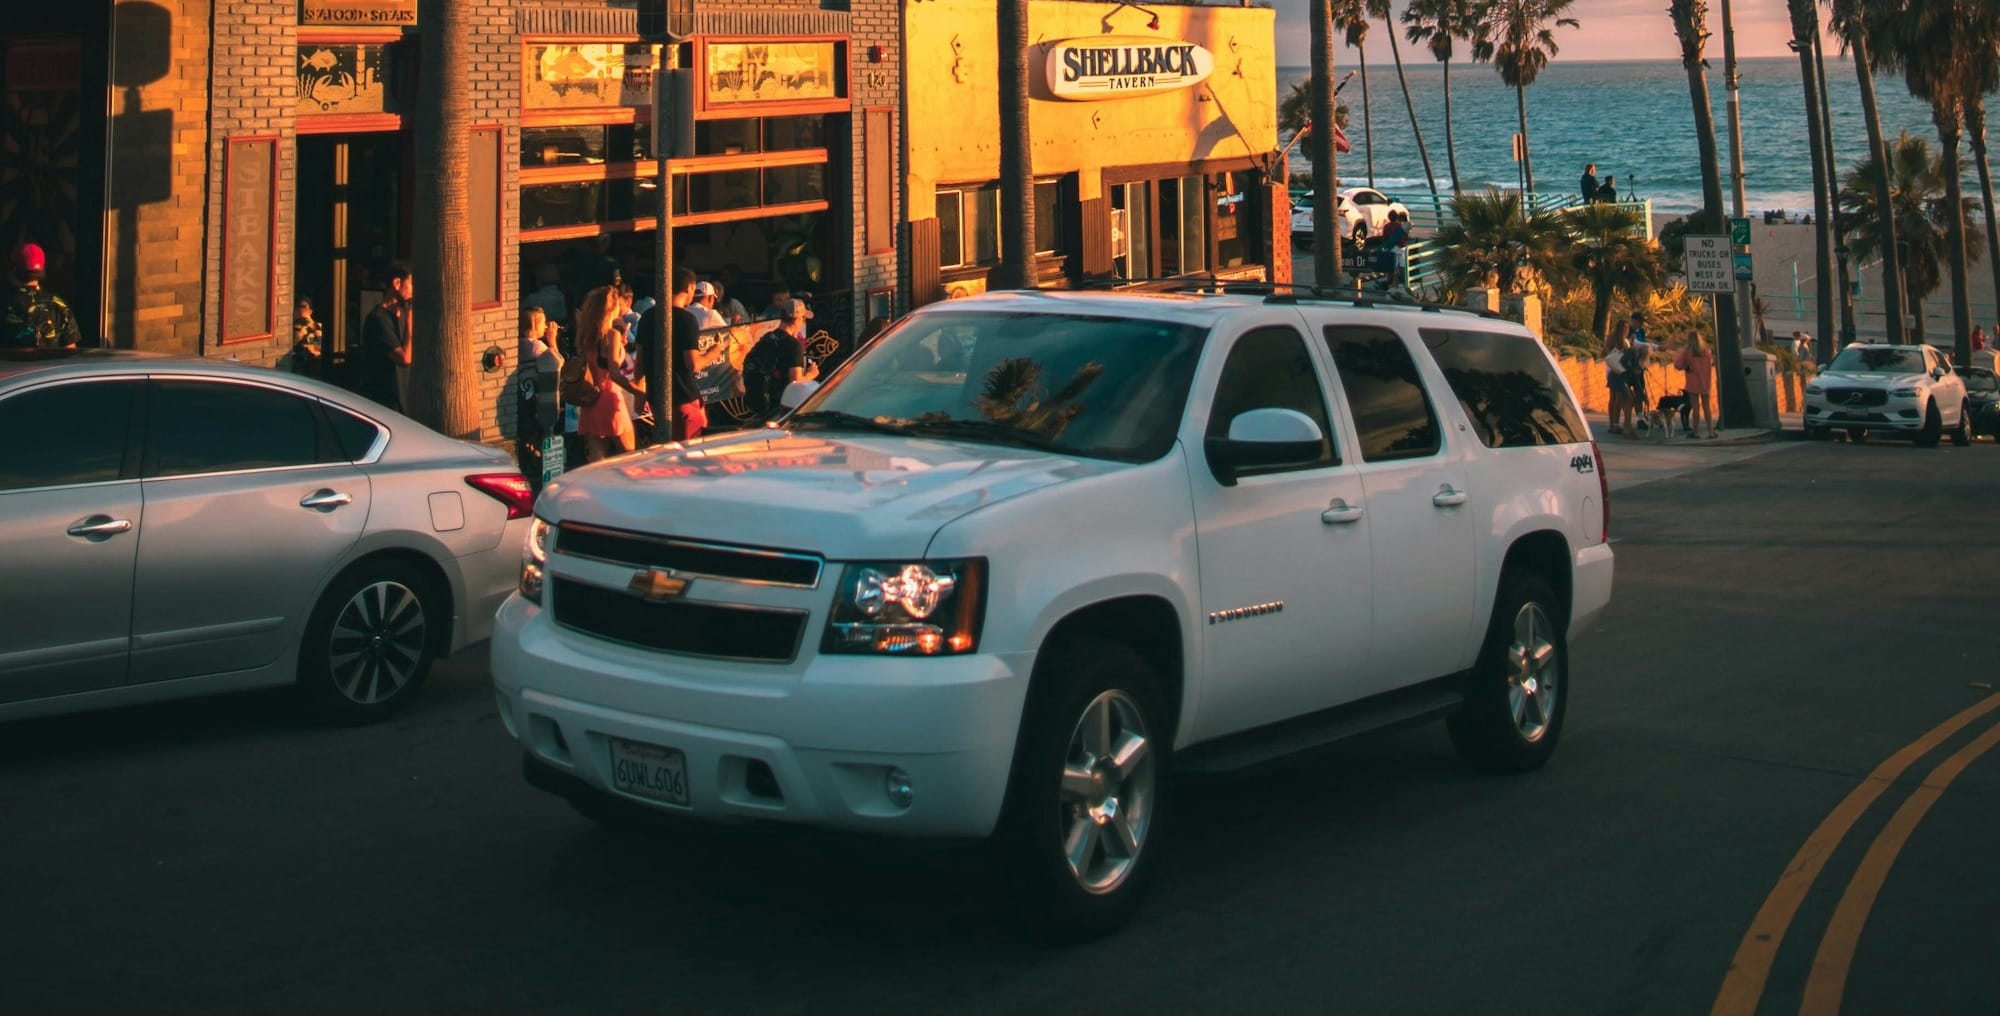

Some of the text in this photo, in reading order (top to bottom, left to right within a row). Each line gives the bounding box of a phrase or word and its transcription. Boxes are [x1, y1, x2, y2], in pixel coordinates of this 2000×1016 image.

[1063, 45, 1198, 82] SHELLBACK
[1109, 76, 1155, 89] TAVERN
[234, 160, 261, 316] STEAKS
[1701, 239, 1714, 249] NO
[1688, 250, 1730, 259] TRUCKS OR
[1356, 255, 1366, 267] Dr
[1697, 260, 1722, 269] BUSES
[1695, 270, 1714, 279] WEST
[1691, 280, 1716, 289] OCEAN
